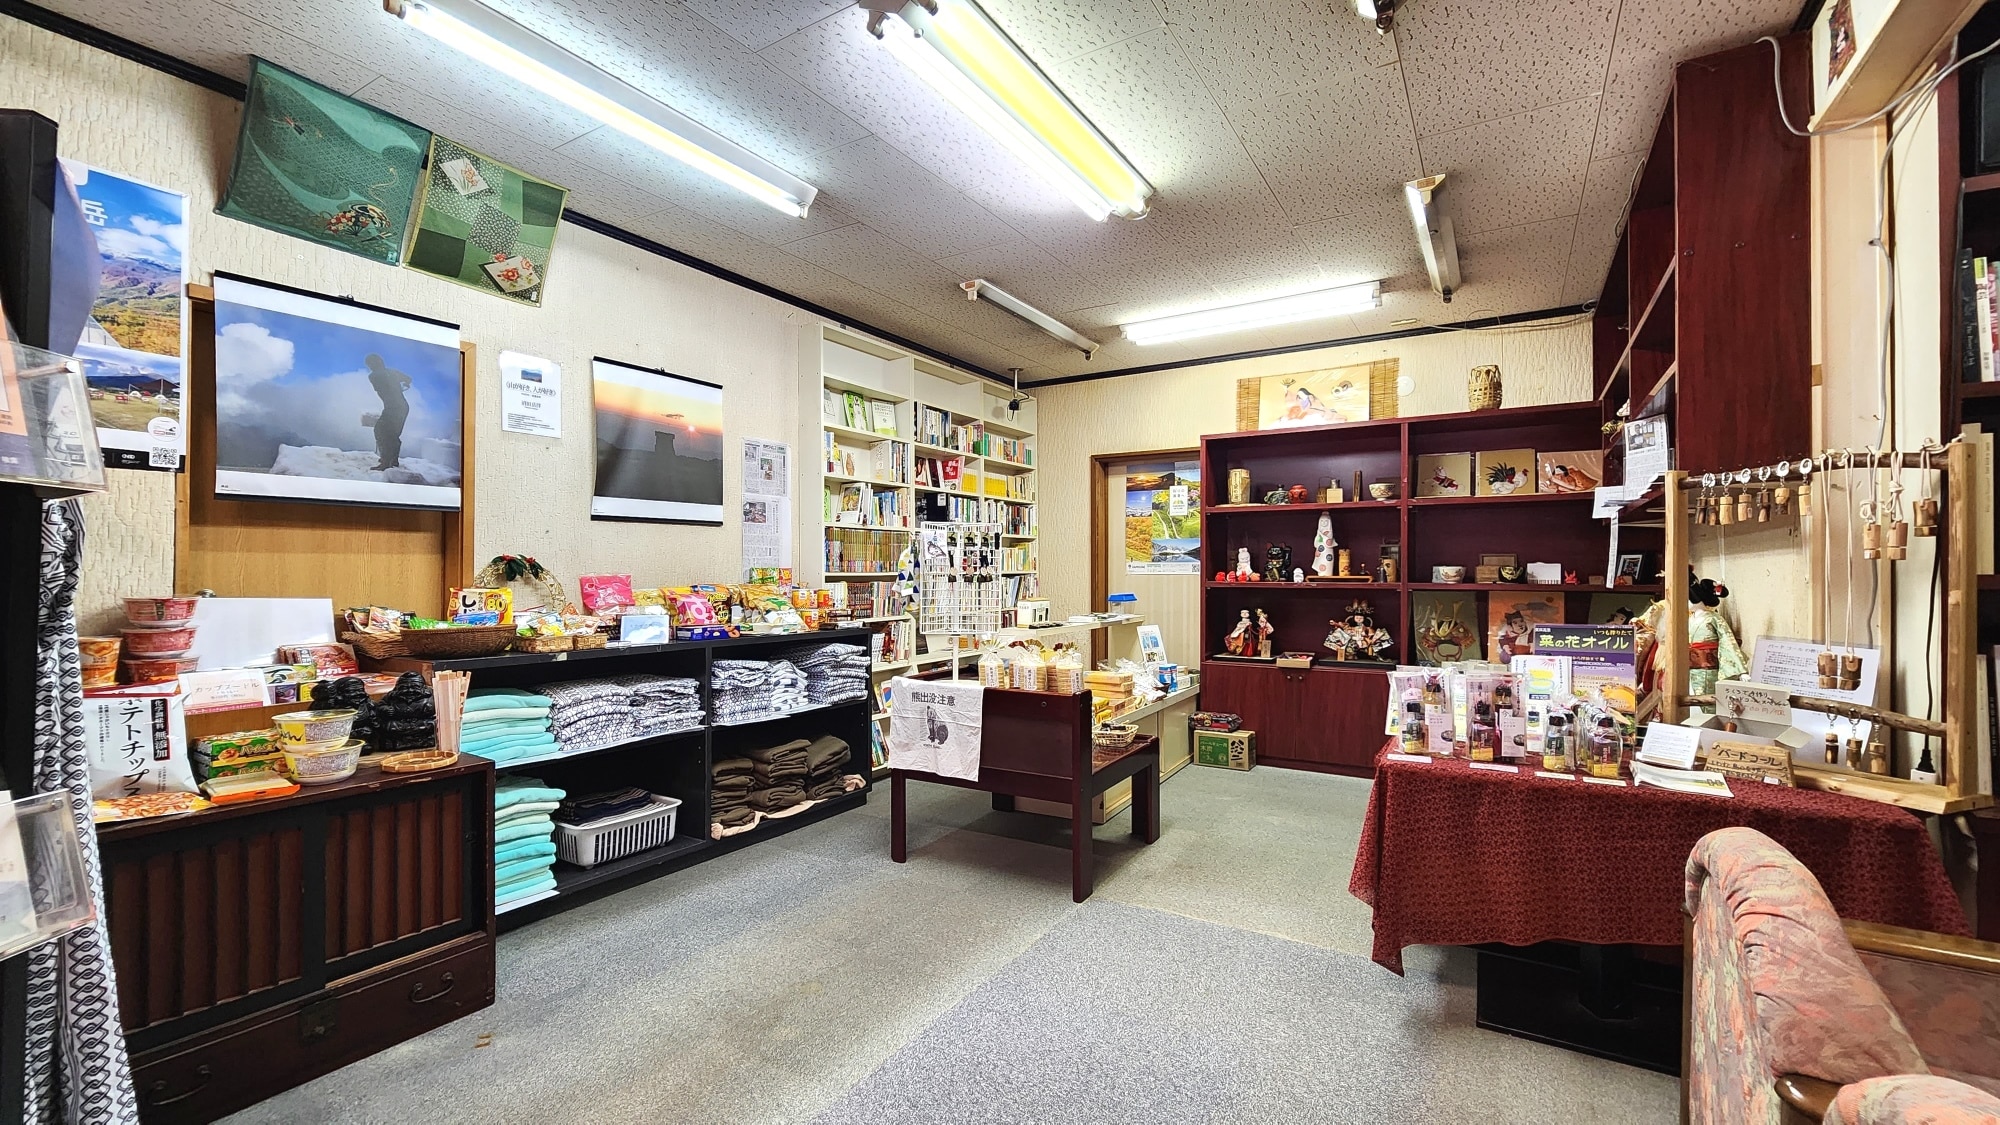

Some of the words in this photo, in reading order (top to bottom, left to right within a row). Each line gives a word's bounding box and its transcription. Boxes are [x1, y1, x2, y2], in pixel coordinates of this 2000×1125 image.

[81, 199, 108, 227] 岳
[486, 598, 506, 611] 80
[1539, 634, 1629, 650] 菜の花オイル
[911, 691, 956, 706] 熊出没注意
[1718, 748, 1783, 767] バードコール
